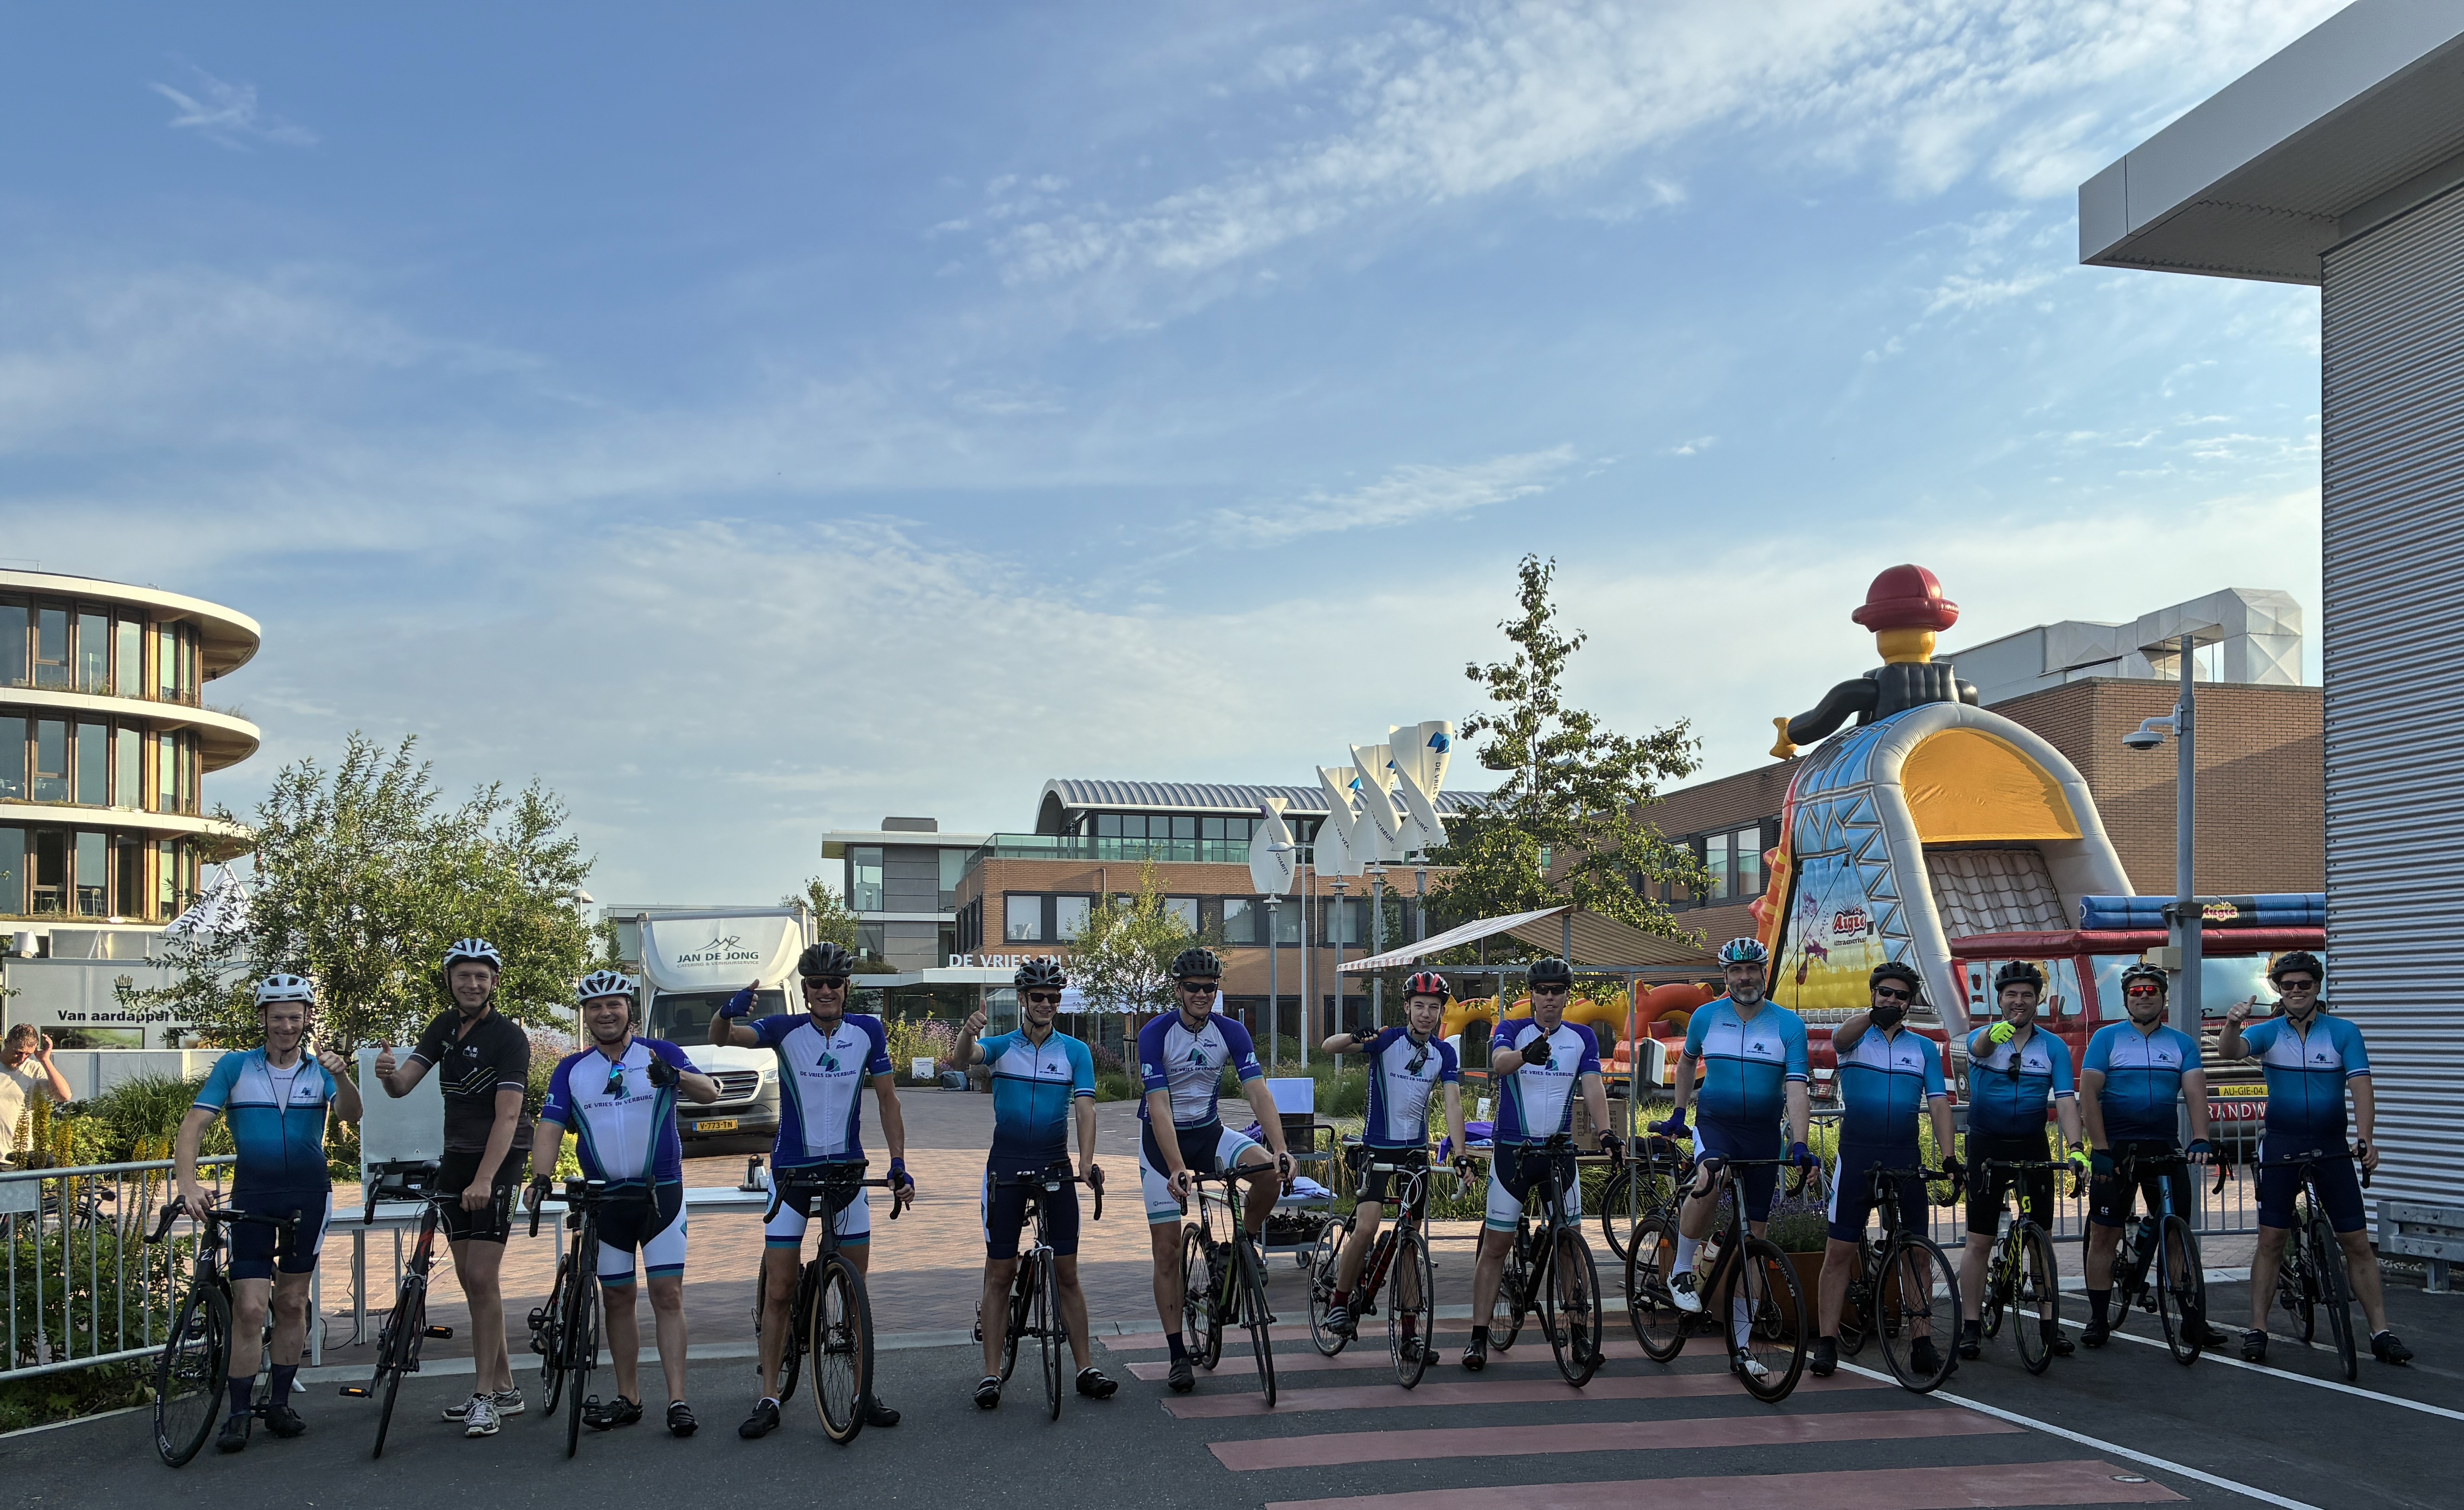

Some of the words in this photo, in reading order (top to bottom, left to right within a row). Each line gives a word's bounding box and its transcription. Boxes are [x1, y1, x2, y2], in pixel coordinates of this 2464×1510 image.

[1435, 762, 1441, 772] DE
[1275, 852, 1289, 876] CHARITY
[677, 953, 701, 963] JAN
[705, 953, 722, 961] DE
[725, 951, 759, 960] JONG
[949, 954, 974, 967] DE
[979, 954, 1031, 967] VRIES
[57, 1010, 87, 1021] Van
[91, 1011, 169, 1024] aardappel
[2224, 1087, 2263, 1096] AU-GIE-04
[624, 1094, 653, 1105] VERBURG
[700, 1121, 733, 1130] V-773-TN
